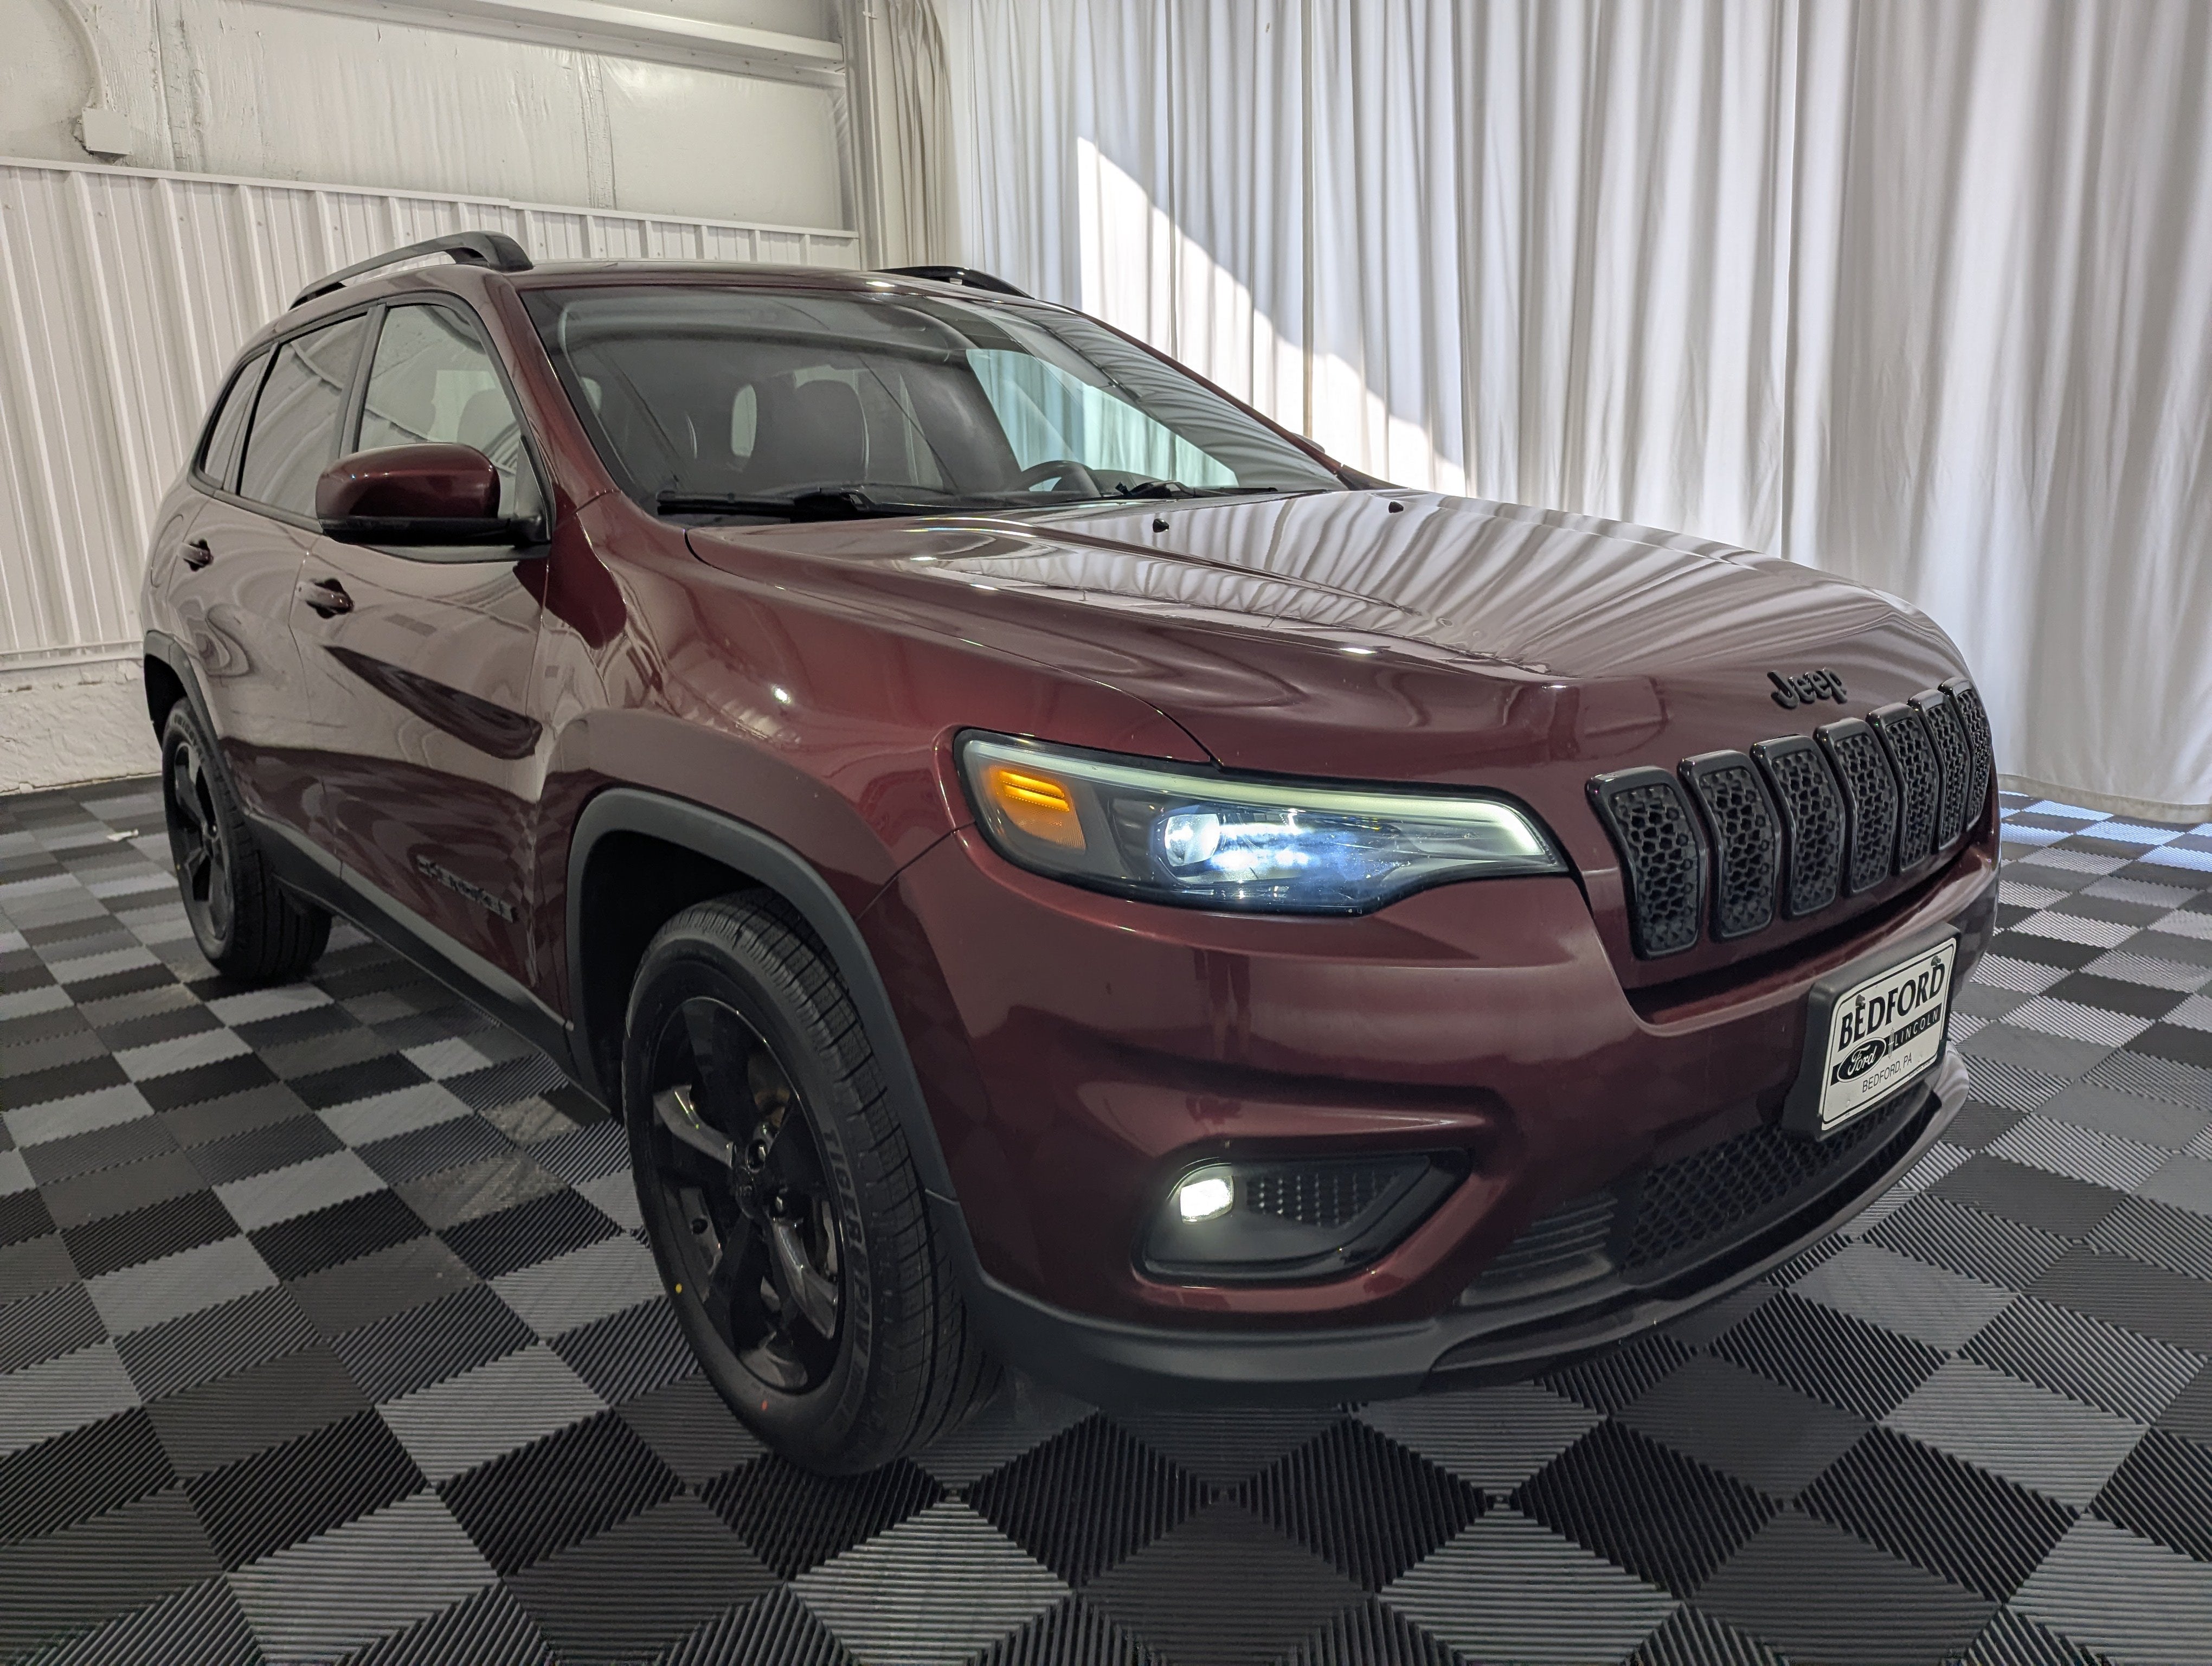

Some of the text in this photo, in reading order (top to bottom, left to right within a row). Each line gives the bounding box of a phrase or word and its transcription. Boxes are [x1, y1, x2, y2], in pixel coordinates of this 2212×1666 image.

[1767, 667, 1847, 710] Jeep
[1838, 963, 1945, 1052] BEDFORD
[1894, 1009, 1939, 1046] LINCOLN
[1848, 1045, 1877, 1076] Ford
[1862, 1061, 1901, 1093] BEDFORD,
[1902, 1052, 1912, 1068] PA
[824, 1129, 863, 1244] TIGER
